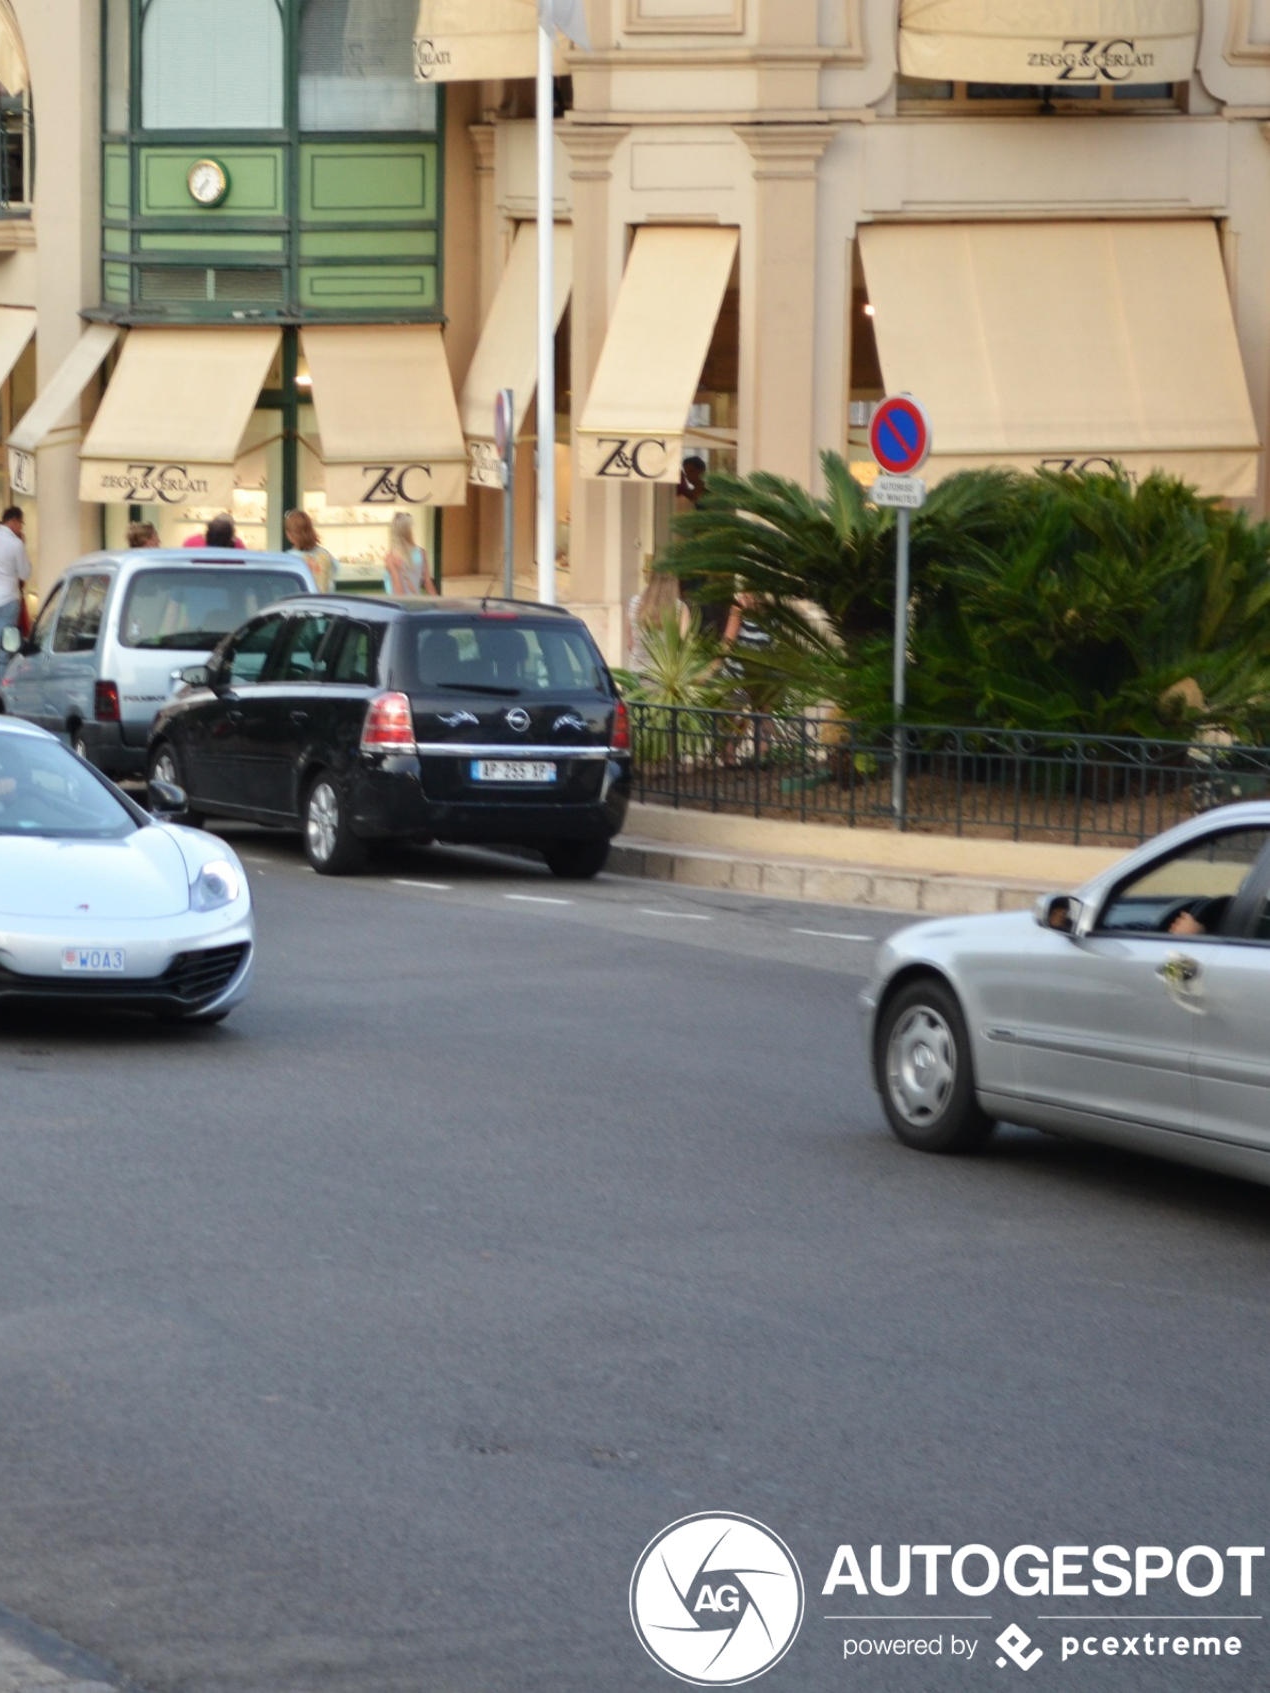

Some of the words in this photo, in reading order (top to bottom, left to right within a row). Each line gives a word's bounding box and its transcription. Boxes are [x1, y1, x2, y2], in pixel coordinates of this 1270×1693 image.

[1027, 52, 1075, 67] ZEGG
[1078, 53, 1090, 67] &
[1093, 52, 1155, 67] CERLATI
[594, 438, 669, 479] Z&C
[100, 474, 138, 489] ZEGG
[140, 477, 150, 490] &
[360, 463, 434, 504] Z&C
